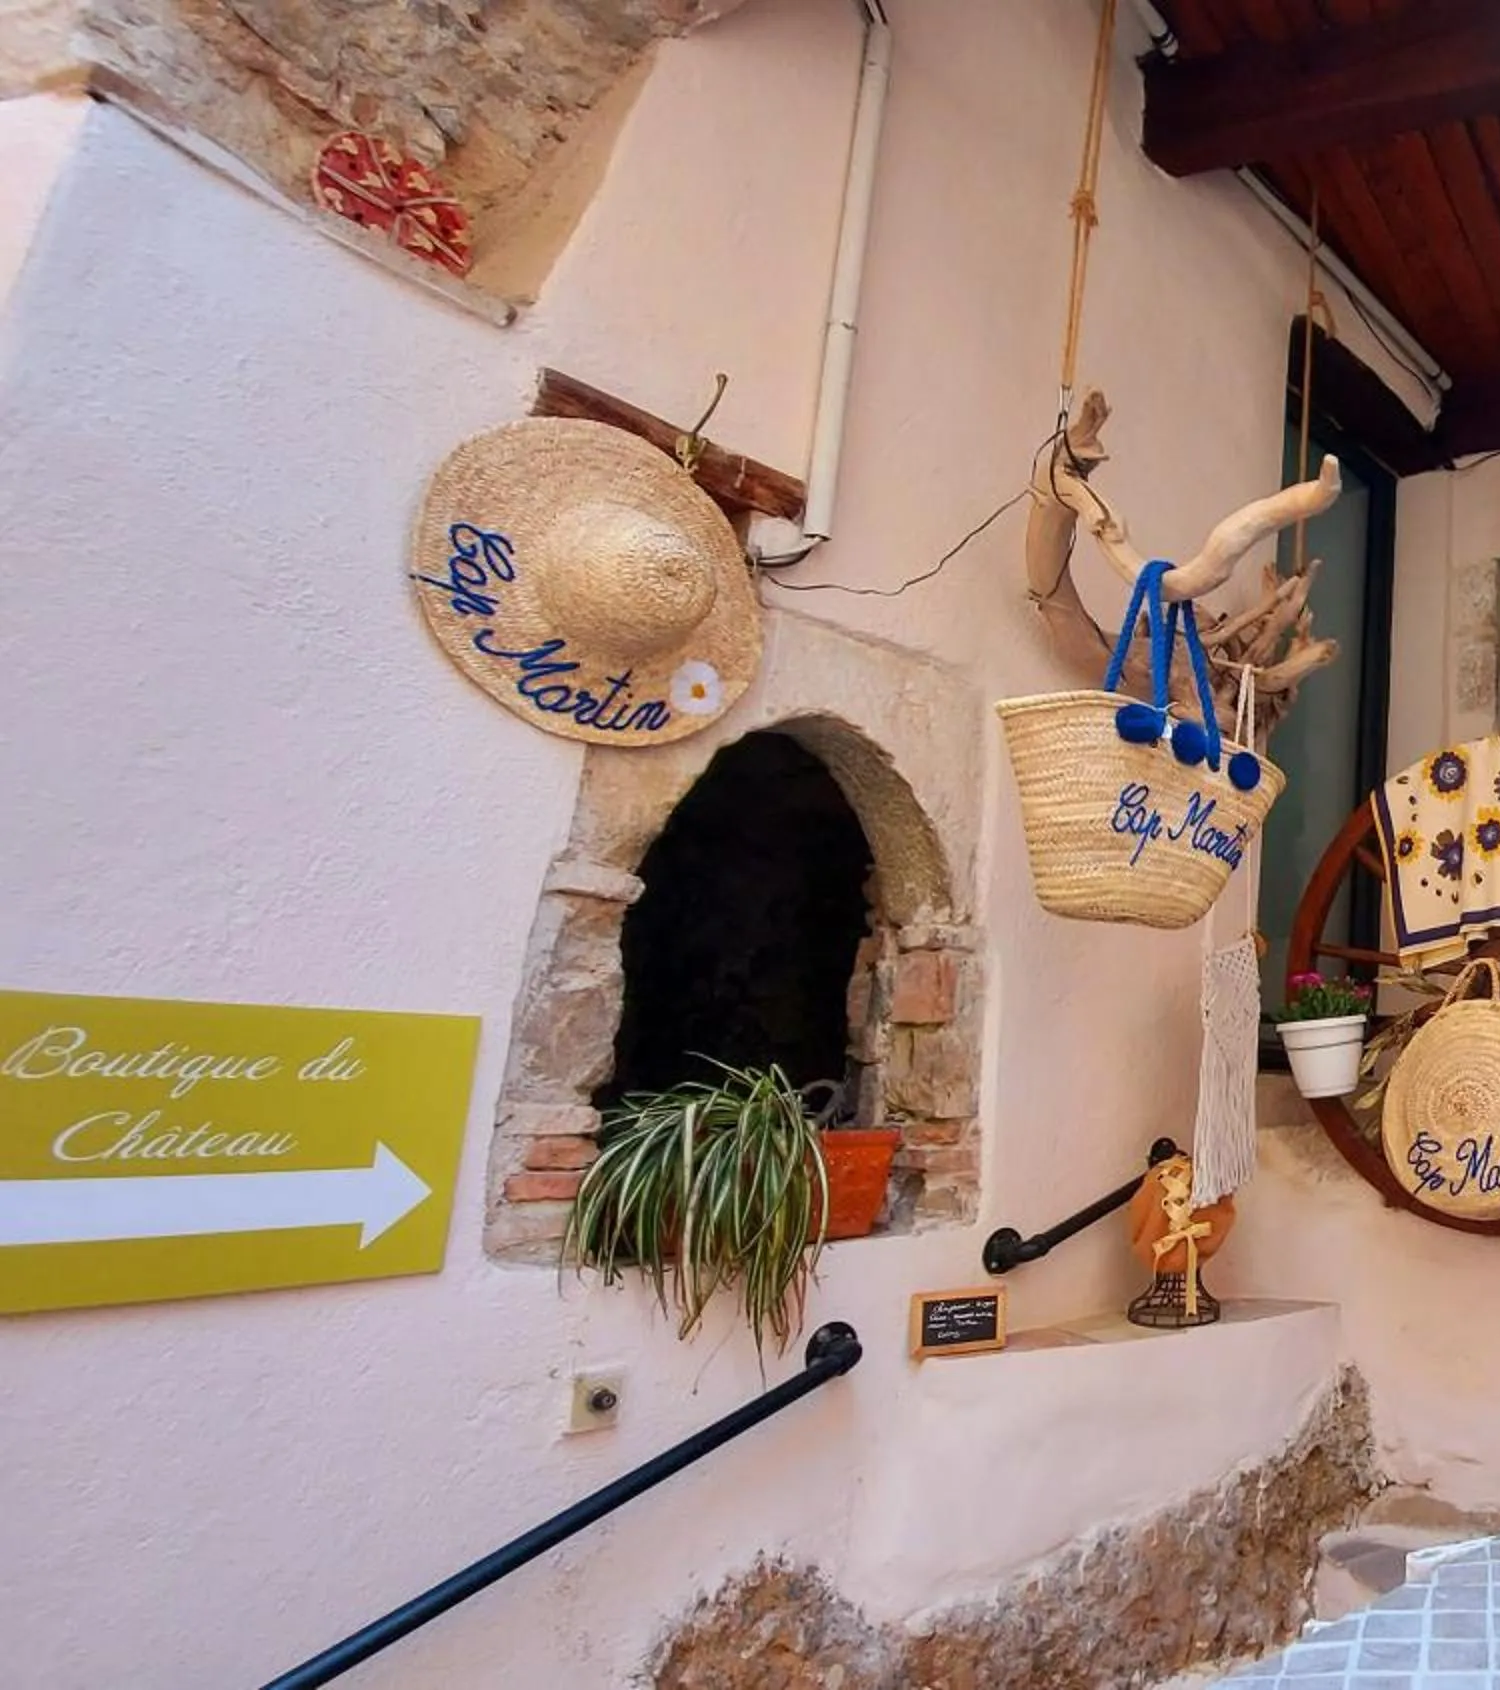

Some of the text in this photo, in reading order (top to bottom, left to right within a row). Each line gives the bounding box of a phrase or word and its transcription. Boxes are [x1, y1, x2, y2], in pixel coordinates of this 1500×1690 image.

[408, 522, 671, 732] Cap Martin
[1111, 782, 1163, 867] Cap
[0, 1026, 366, 1099] Boutique du
[52, 1109, 299, 1162] Château
[1407, 1130, 1445, 1195] Cap
